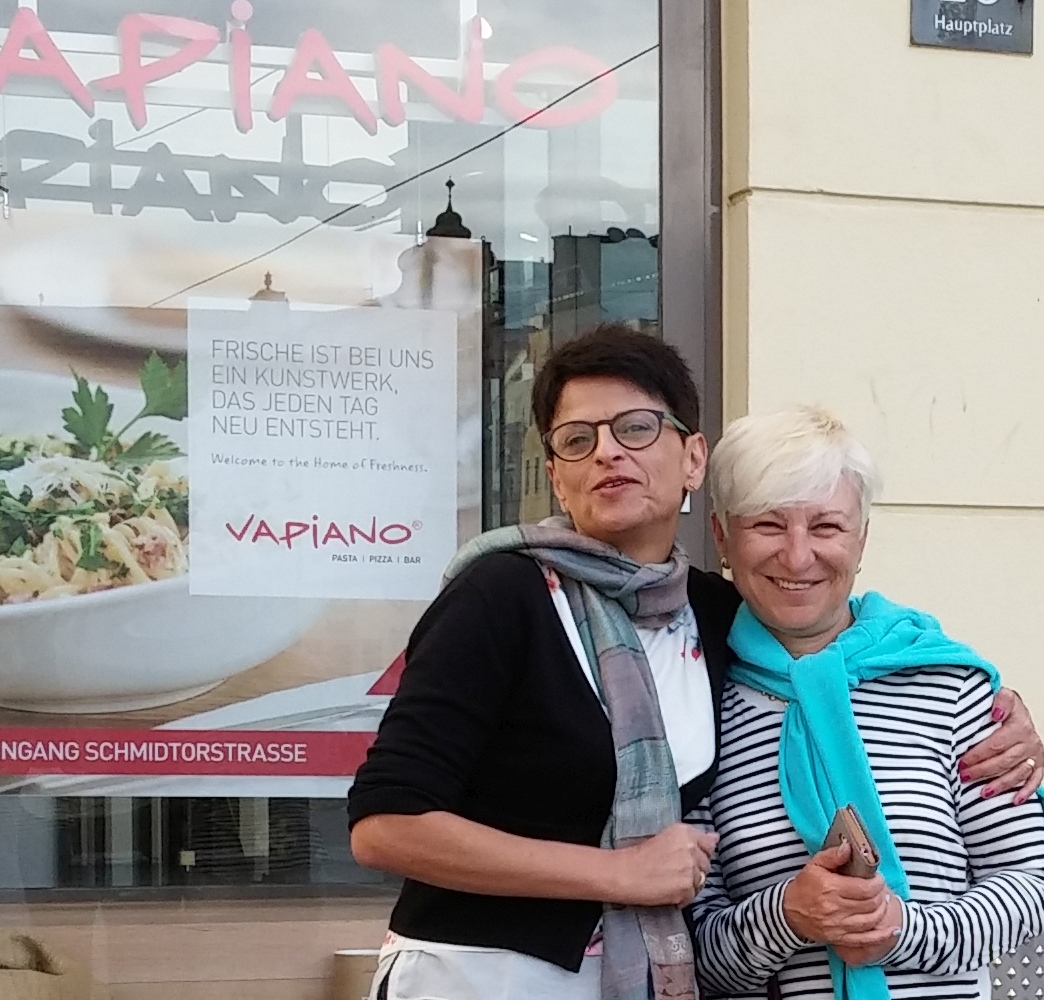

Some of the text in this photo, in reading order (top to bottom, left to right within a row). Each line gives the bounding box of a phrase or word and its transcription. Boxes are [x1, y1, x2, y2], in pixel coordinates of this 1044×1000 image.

[934, 14, 1014, 37] Hauptplatz
[212, 339, 434, 369] FRISCHE IST BEI UNS
[212, 364, 399, 395] EIN KUNSTWERK,
[212, 389, 379, 416] DAS JEDEN TAG
[212, 415, 380, 441] NEU ENTSTEHT.
[211, 453, 429, 473] Welcome to the Home of Freshness.
[331, 554, 422, 564] PASTA PIZZA BAR
[1, 741, 308, 763] NGANG SCHMIDTORSTRASSE
